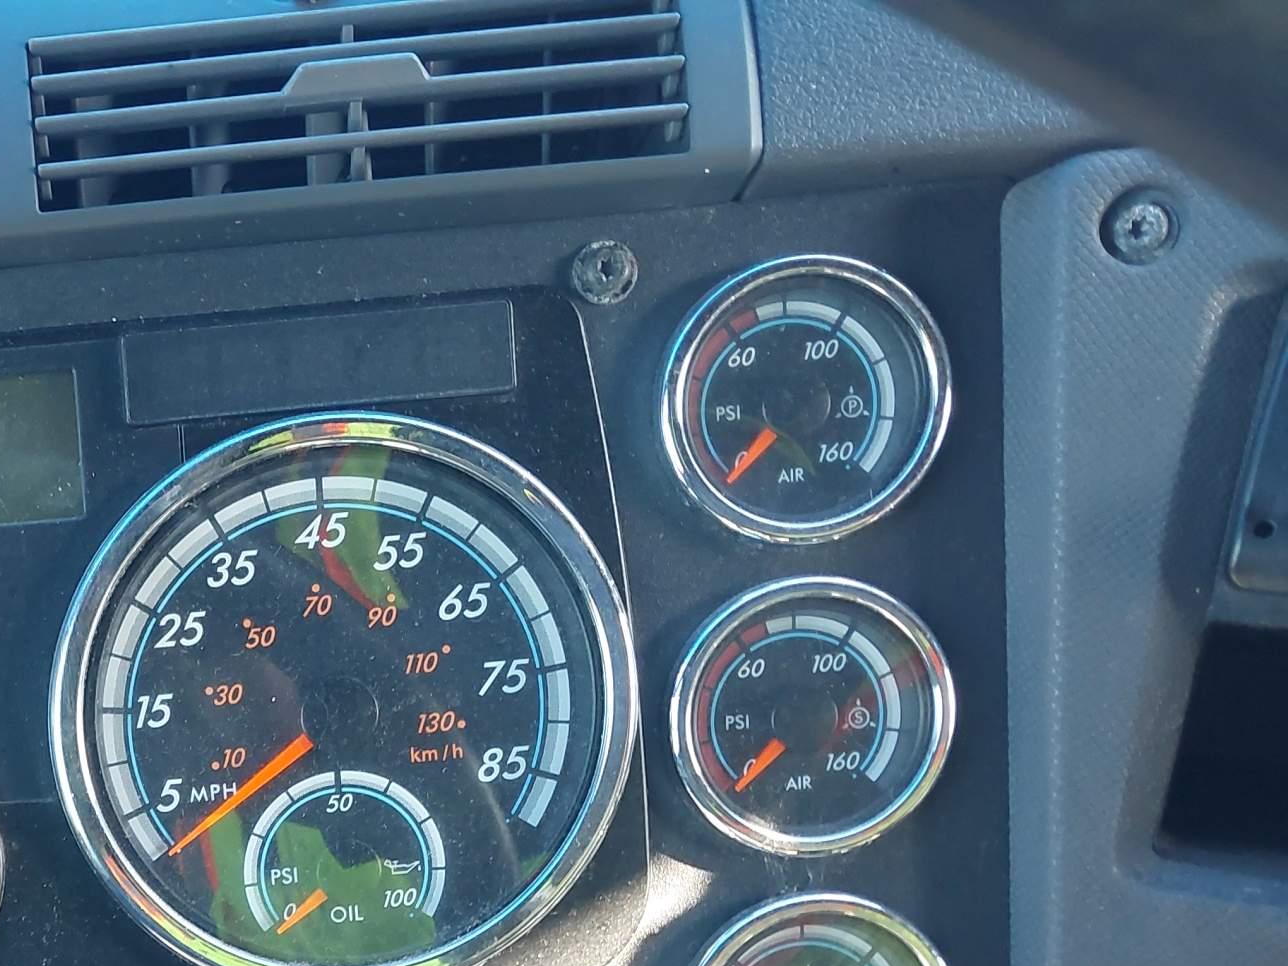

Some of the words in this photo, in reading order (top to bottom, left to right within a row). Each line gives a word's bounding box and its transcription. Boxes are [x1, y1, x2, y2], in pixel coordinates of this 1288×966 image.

[728, 347, 755, 368] 60
[804, 340, 839, 360] 100
[716, 405, 740, 421] PSI
[819, 442, 853, 462] 160
[778, 469, 804, 483] AIR
[295, 513, 348, 549] 45
[374, 532, 426, 571] 55
[207, 550, 258, 588] 35
[304, 595, 331, 617] 70
[438, 583, 490, 620] 65
[367, 606, 397, 628] 90
[154, 611, 206, 649] 25
[245, 627, 276, 649] 50
[405, 653, 438, 674] 110
[738, 659, 765, 678] 60
[812, 653, 846, 674] 100
[478, 659, 529, 696] 75
[212, 684, 243, 705] 30
[136, 694, 172, 729] 15
[725, 714, 750, 729] PSI
[417, 712, 456, 734] 130
[224, 748, 246, 769] 10
[410, 743, 464, 764] km/h
[477, 745, 529, 783] 85
[826, 752, 860, 771] 160
[785, 776, 812, 791] AIR
[157, 779, 183, 812] 5
[191, 782, 237, 803] MPH
[325, 794, 353, 814] 50
[271, 868, 298, 886] PSI
[384, 888, 417, 908] 100
[284, 903, 296, 921] 0
[331, 905, 364, 922] OIL
